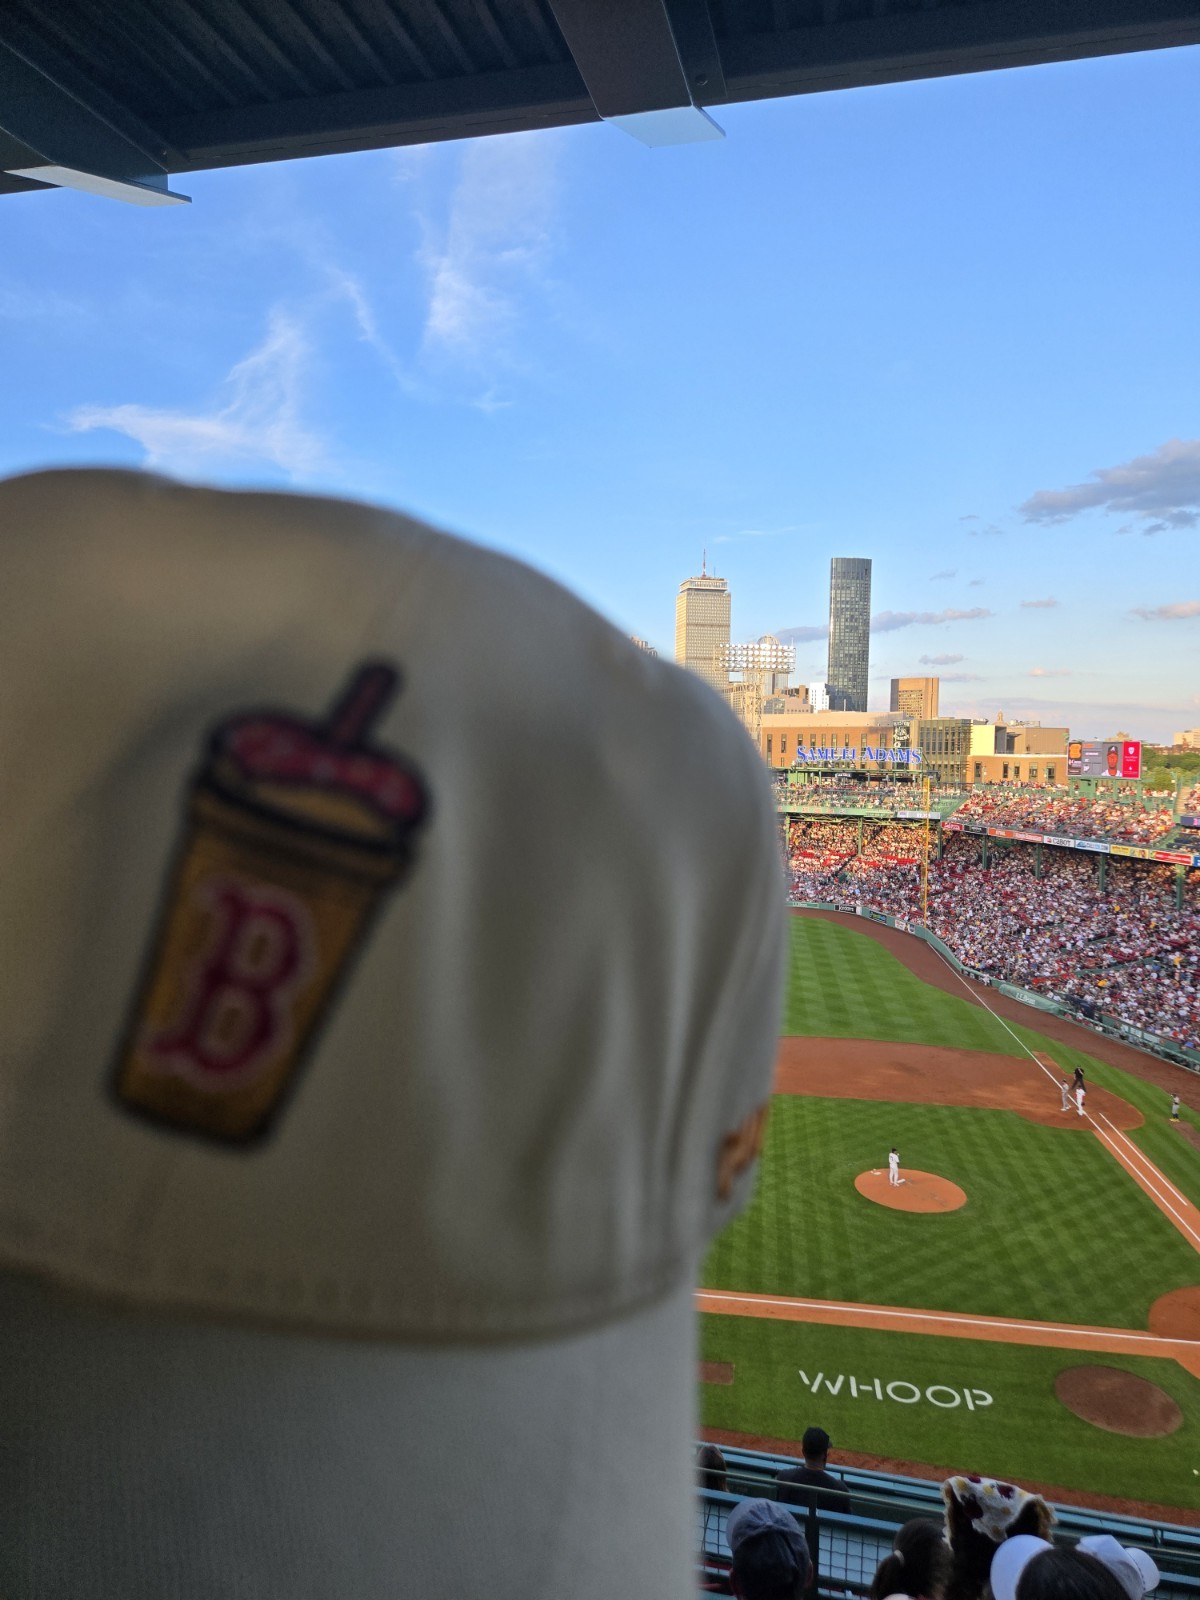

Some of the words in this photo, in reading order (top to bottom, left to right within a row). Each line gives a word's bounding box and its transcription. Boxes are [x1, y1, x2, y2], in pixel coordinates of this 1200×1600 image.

[797, 746, 856, 762] SAMUEL
[862, 746, 922, 764] ADAMS
[145, 880, 309, 1084] B
[799, 1370, 993, 1411] WHOOP
